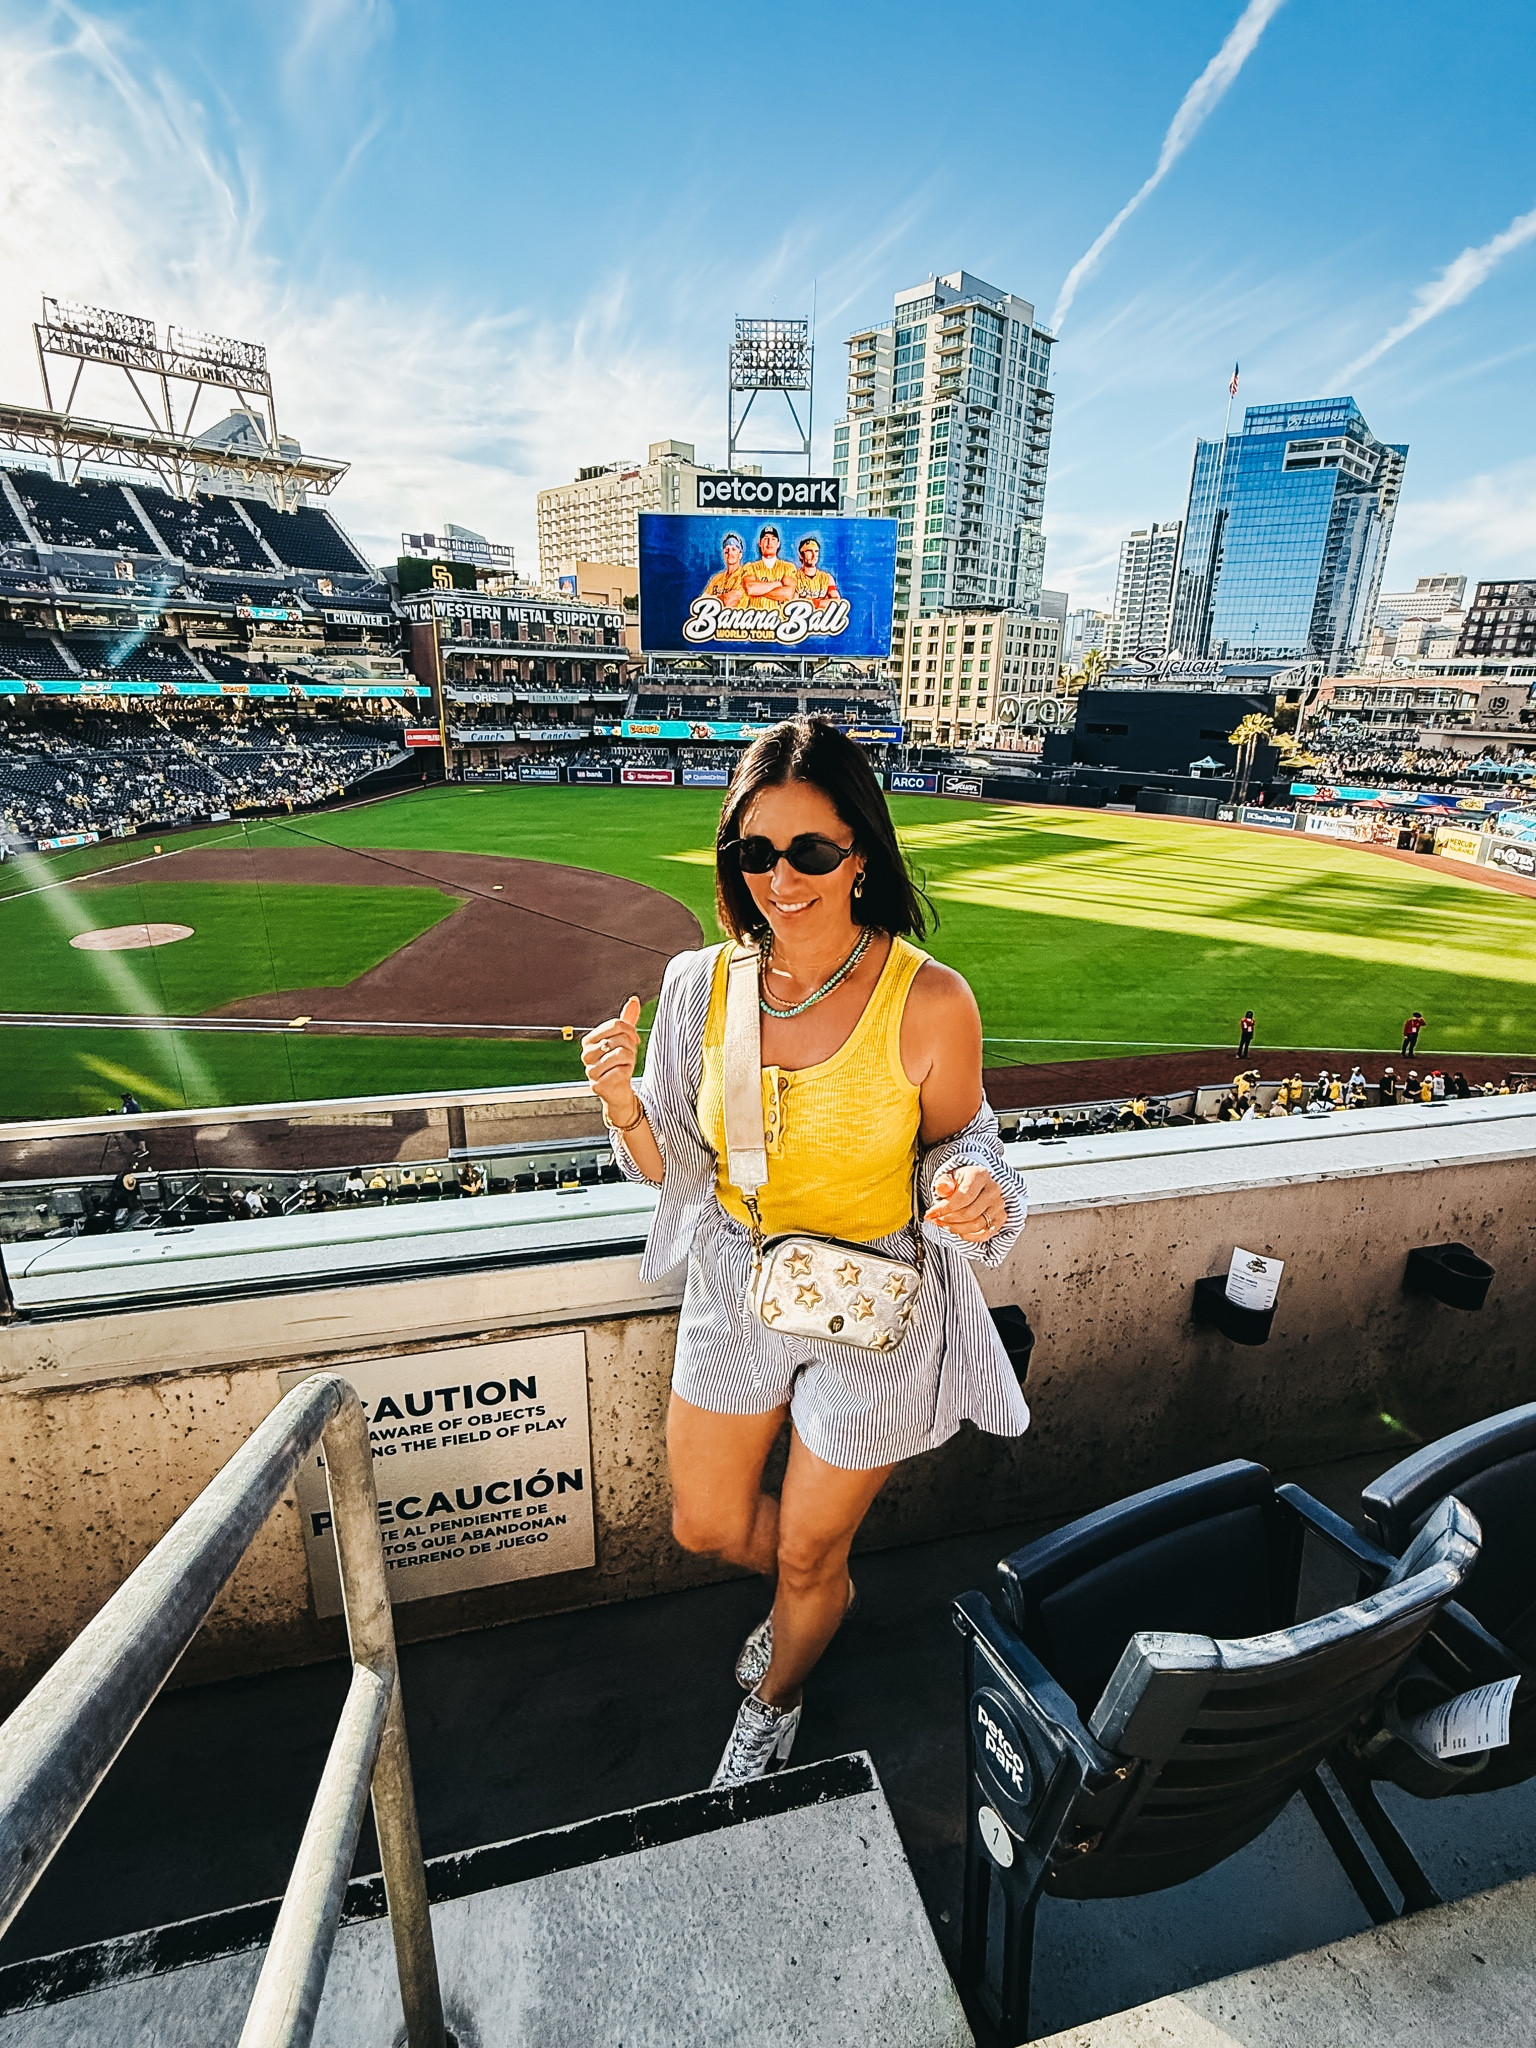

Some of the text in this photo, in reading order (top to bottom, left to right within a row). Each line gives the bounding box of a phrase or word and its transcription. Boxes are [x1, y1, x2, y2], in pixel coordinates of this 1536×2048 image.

[1302, 411, 1345, 424] SEMPRA
[699, 478, 836, 508] petco park
[333, 613, 383, 626] CUTWATER
[434, 601, 624, 629] WESTERN METAL SUPPLY CO.
[684, 598, 849, 643] Banana Ball
[716, 629, 775, 640] WORLD TOUR
[1131, 647, 1223, 681] Sycuan
[472, 693, 499, 703] ORIS
[1492, 696, 1506, 709] 19
[1022, 699, 1078, 726] raz
[504, 771, 517, 780] 342
[530, 768, 557, 777] Palomar
[586, 770, 603, 779] bank
[637, 773, 669, 781] Snapdragon
[893, 777, 925, 788] ARCO
[1218, 810, 1234, 822] 396
[1449, 838, 1477, 849] MERCURY
[369, 1405, 546, 1441] AWARE OF OBJECTS
[401, 1417, 568, 1453] THE FIELD OF PLAY
[311, 1467, 584, 1537] PECAUCIÓN
[403, 1524, 427, 1538] AL
[430, 1508, 523, 1534] PENDIENTE
[526, 1504, 548, 1516] DE
[421, 1535, 457, 1550] QUE
[460, 1514, 567, 1543] ABANDONAN
[386, 1546, 465, 1570] TERRENO
[469, 1542, 492, 1555] DE
[495, 1532, 549, 1550] JUEGO
[977, 1704, 1025, 1774] petco
[985, 1730, 1024, 1793] park
